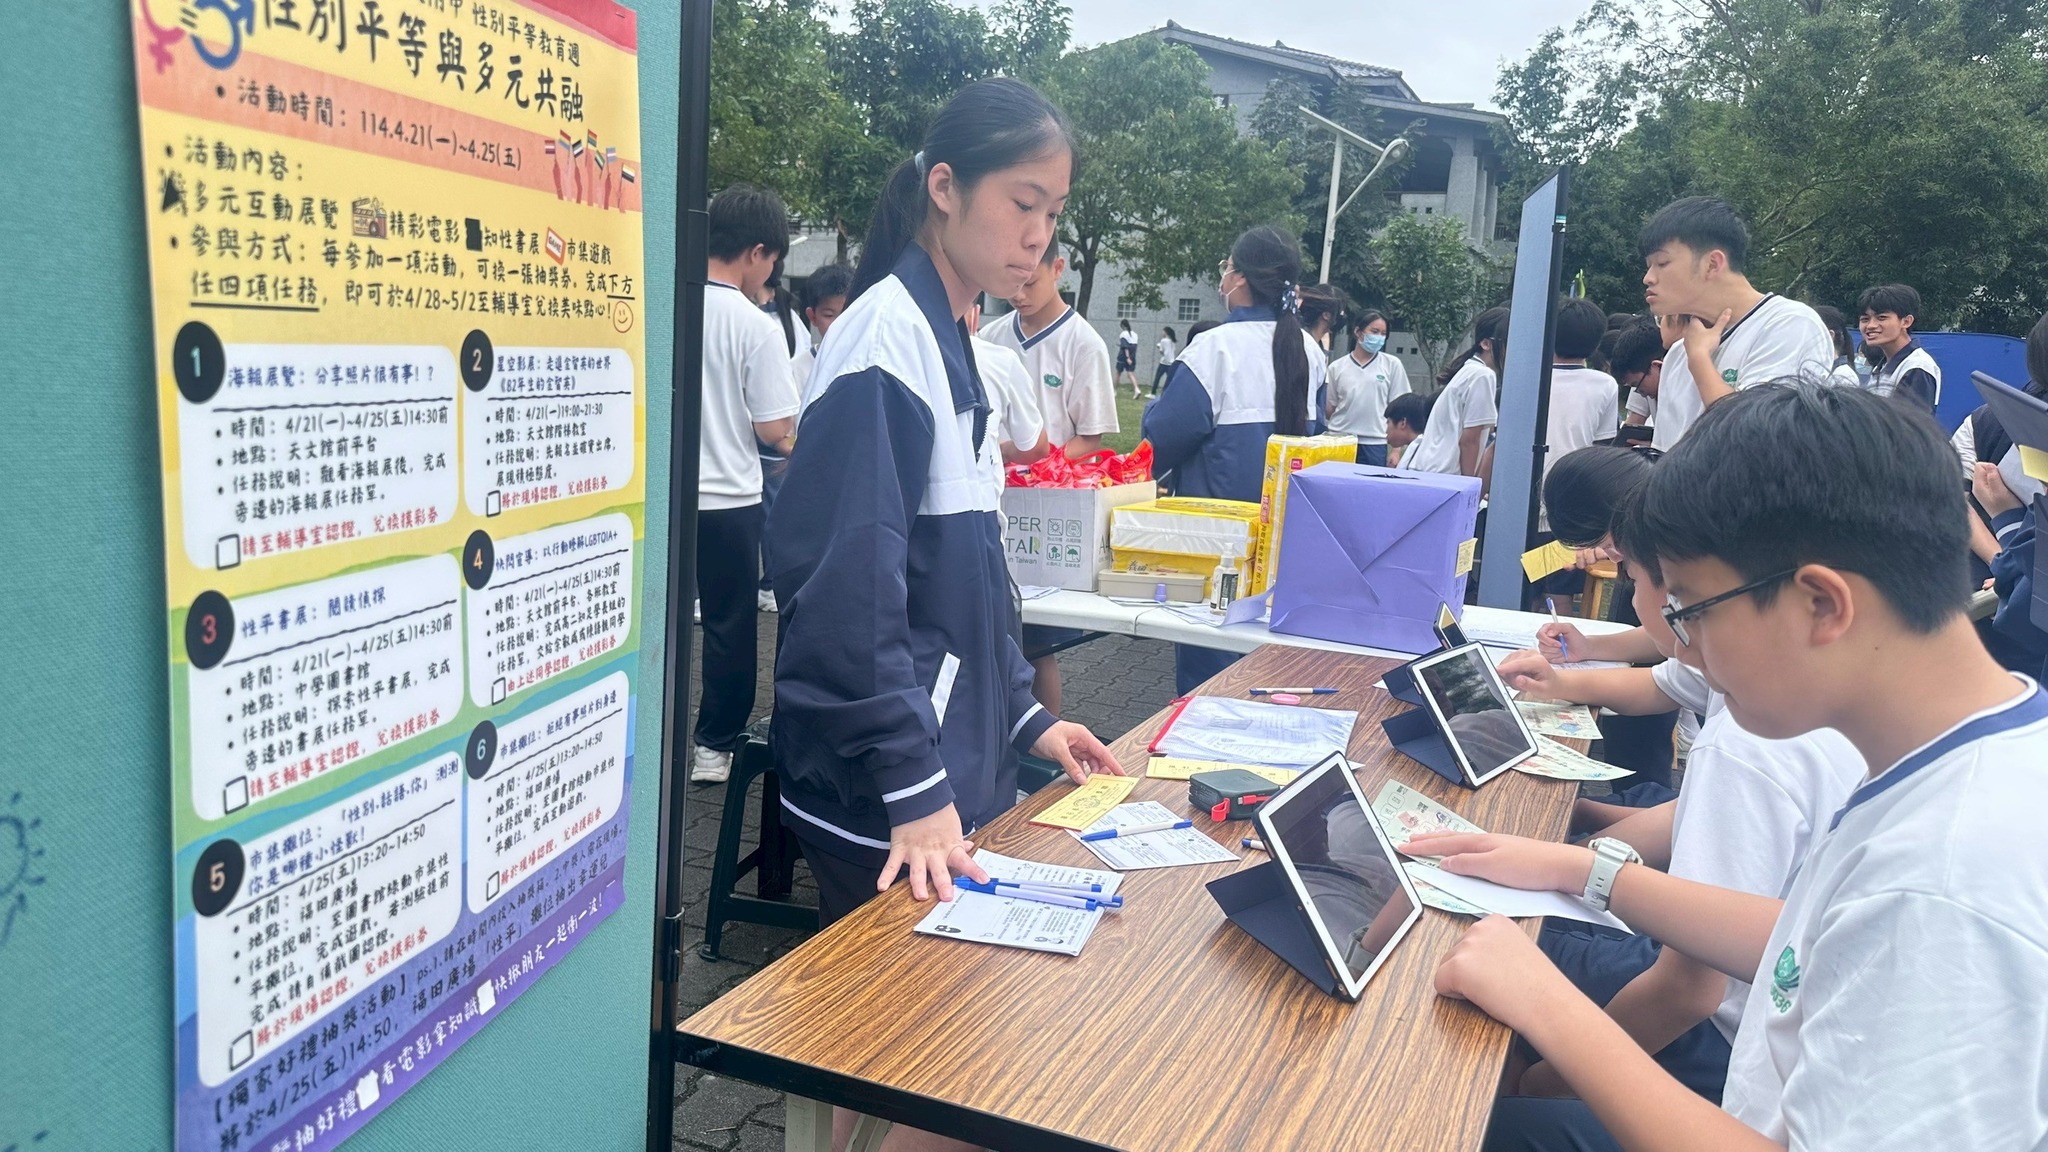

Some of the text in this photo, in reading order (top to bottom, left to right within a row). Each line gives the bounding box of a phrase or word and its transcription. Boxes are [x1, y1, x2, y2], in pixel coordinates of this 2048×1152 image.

[473, 2, 581, 68] 性別平等教育週
[195, 180, 540, 256] 多元互動展覽 精彩電影 知性書展
[567, 238, 612, 266] 市集遊戲
[190, 346, 201, 378] 1
[472, 349, 482, 371] 2
[1008, 516, 1041, 533] PER
[1005, 536, 1041, 555] TAR
[1048, 552, 1060, 560] UP
[473, 549, 483, 570] 4
[1015, 557, 1038, 565] Taiwan
[202, 615, 217, 644] 3
[476, 739, 486, 760] 6
[209, 862, 225, 892] 5
[382, 997, 480, 1085] 看電影拿知識
